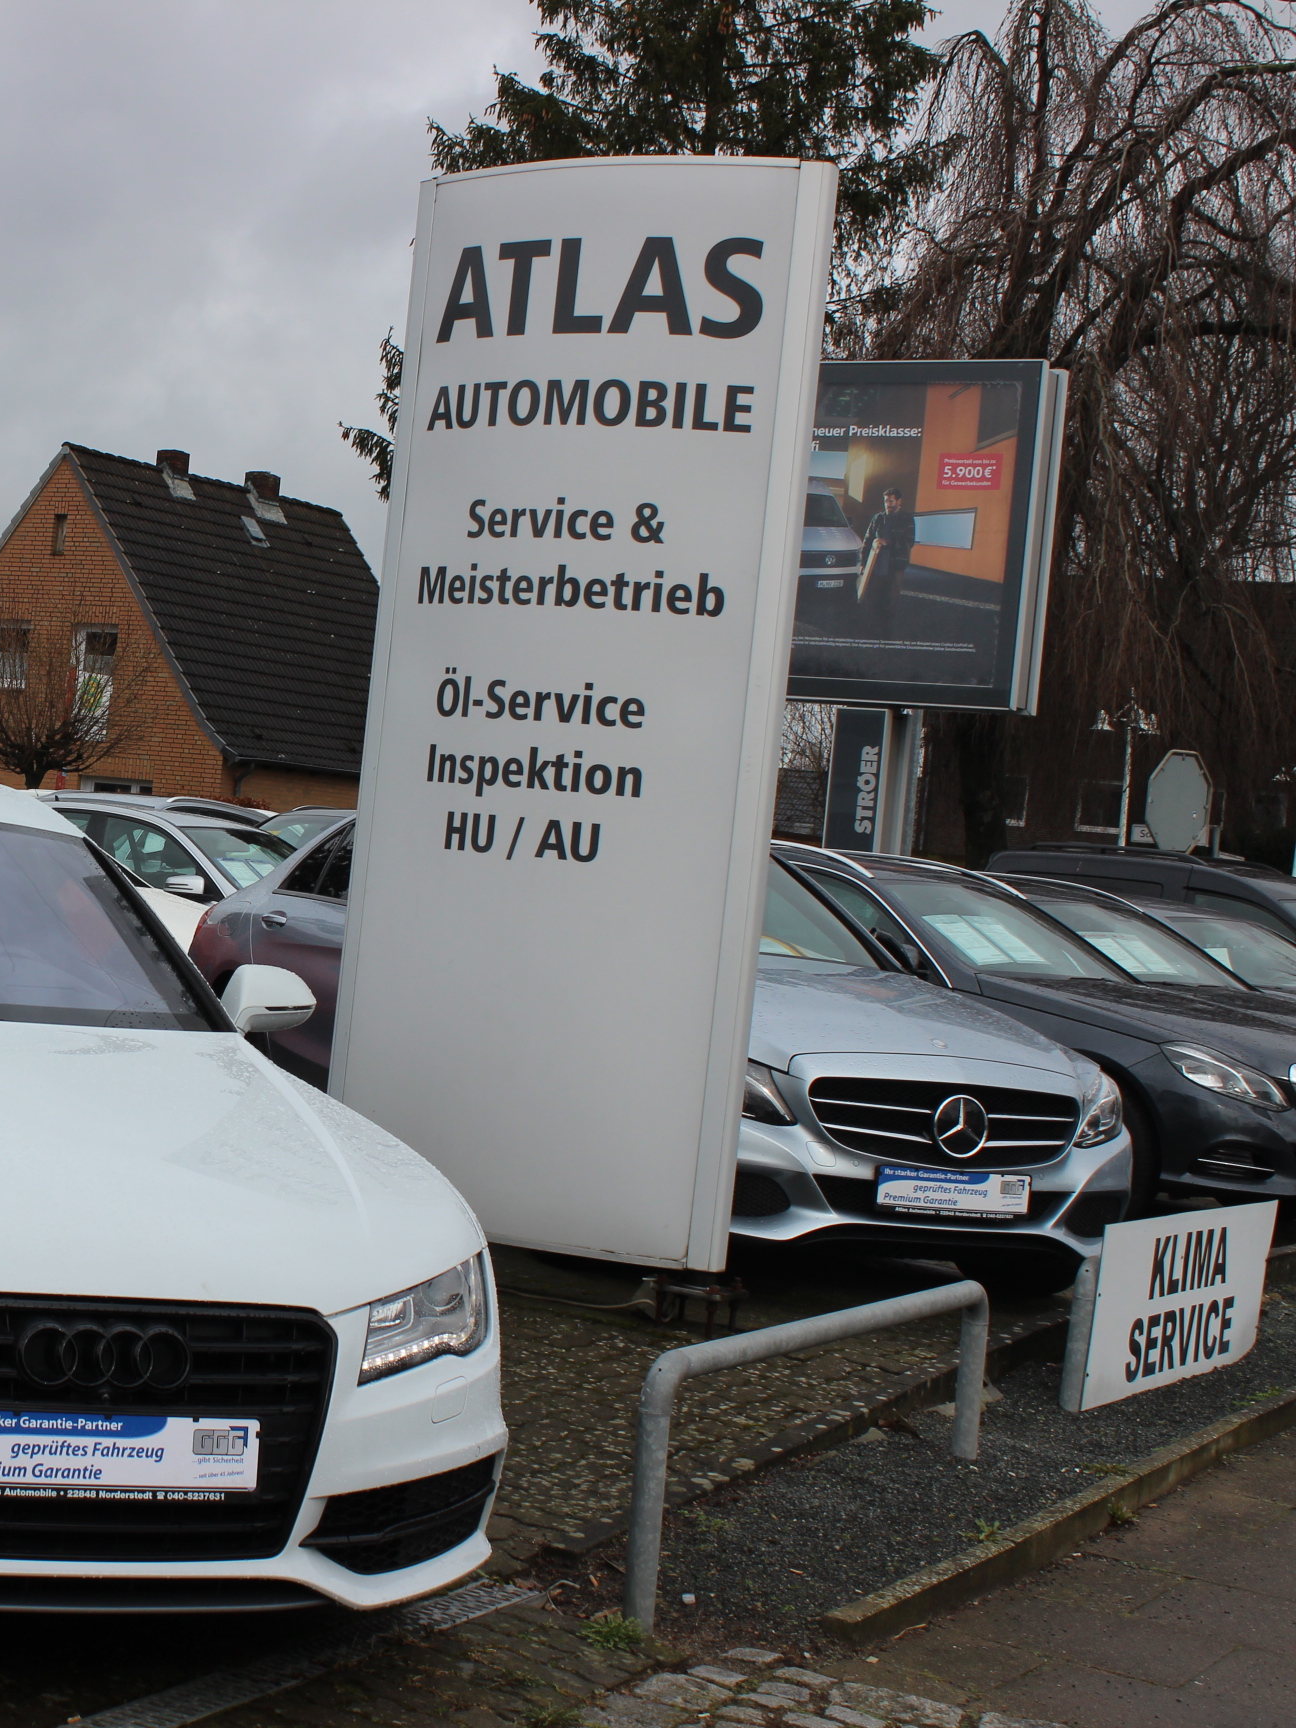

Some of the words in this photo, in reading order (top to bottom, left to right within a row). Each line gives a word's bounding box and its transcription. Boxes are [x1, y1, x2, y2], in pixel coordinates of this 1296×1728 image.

[435, 236, 764, 343] ATLAS
[426, 378, 755, 433] AUTOMOBILE
[849, 425, 922, 437] Preisklasse:
[943, 466, 983, 478] 5.900
[466, 496, 615, 541] Service
[630, 502, 665, 544] &
[417, 562, 725, 618] Meisterbetrieb
[436, 667, 646, 729] Öl-Service
[426, 743, 643, 798] Inspektion
[854, 745, 880, 835] STRÖER
[444, 811, 496, 853] HU
[505, 816, 525, 860] /
[534, 819, 601, 863] AU
[884, 1167, 894, 1175] Ihr
[894, 1169, 918, 1177] starker
[918, 1170, 969, 1181] Garantie-Partner
[912, 1183, 952, 1194] geprüftes
[952, 1186, 988, 1198] Fahrzeug
[883, 1192, 921, 1204] Premium
[923, 1195, 958, 1206] Garantie
[1147, 1226, 1227, 1301] KLIMA
[1125, 1295, 1235, 1383] SERVICE
[19, 1416, 123, 1431] Garantie-Partner
[10, 1440, 88, 1459] geprüftes
[91, 1442, 165, 1462] Fahrzeug
[31, 1462, 103, 1480] Garantie
[4, 1487, 57, 1498] Automobile
[66, 1489, 97, 1499] 22848
[98, 1489, 153, 1500] Norderstedt
